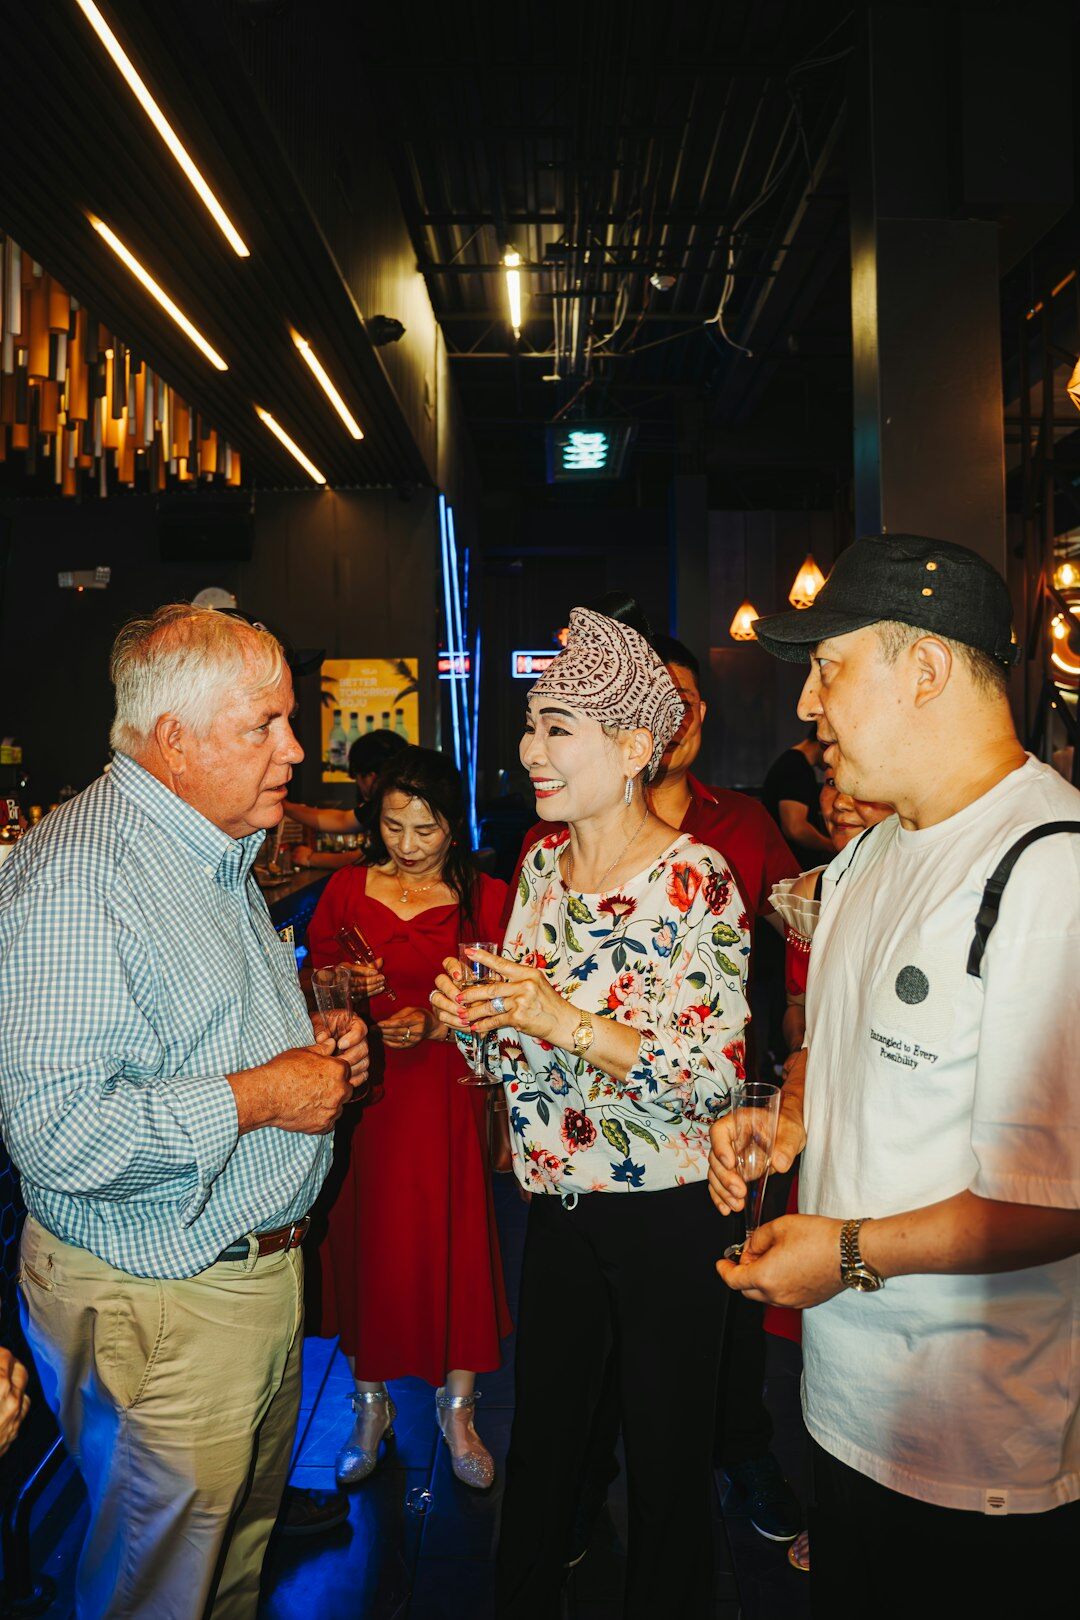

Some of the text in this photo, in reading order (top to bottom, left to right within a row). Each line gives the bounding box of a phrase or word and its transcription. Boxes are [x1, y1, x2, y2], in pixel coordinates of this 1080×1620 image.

[339, 678, 377, 687] BETTER
[339, 688, 399, 697] TOMORROW
[880, 1047, 918, 1069] Possibility
[904, 1043, 911, 1052] to
[913, 1044, 938, 1063] Every
